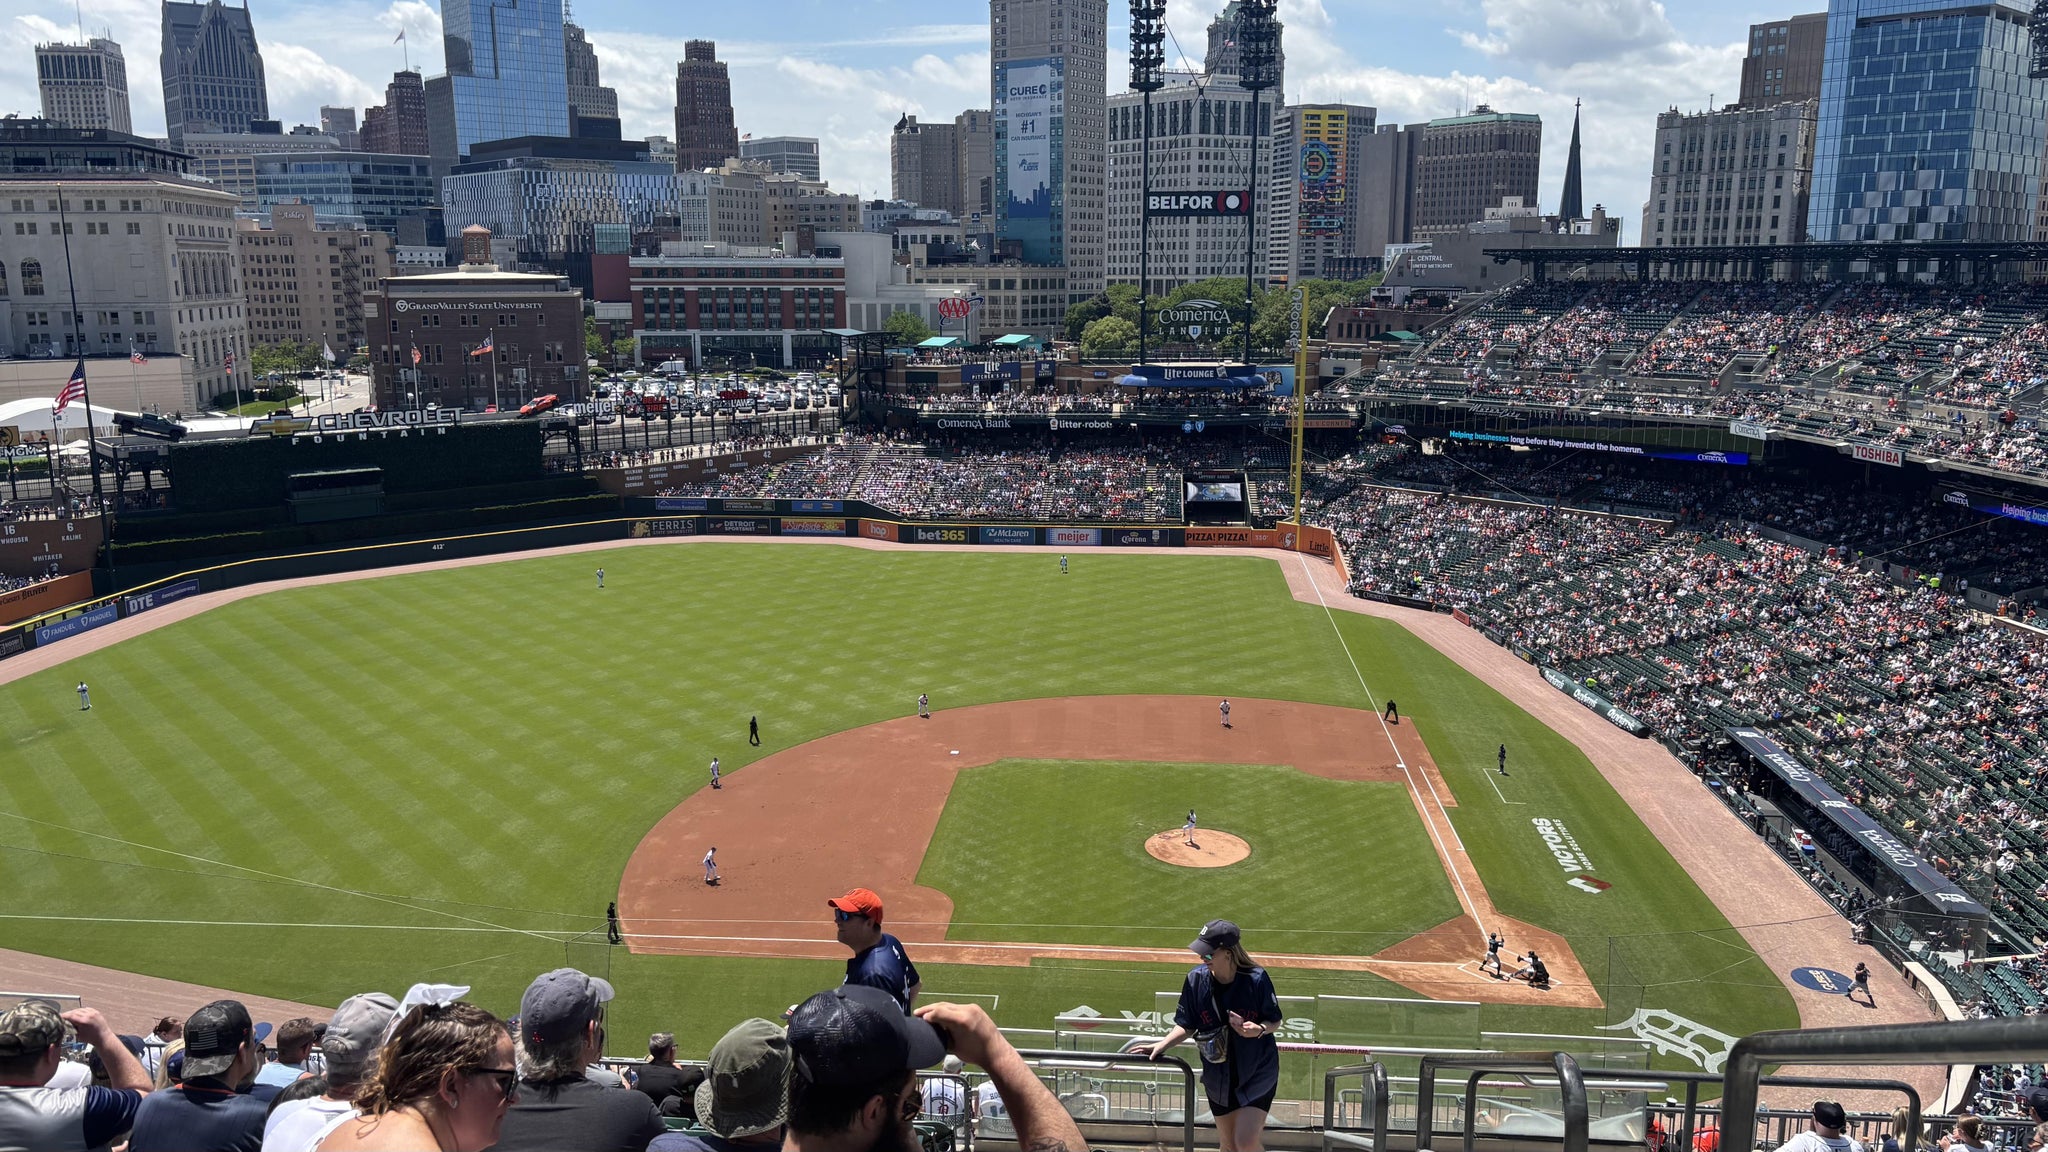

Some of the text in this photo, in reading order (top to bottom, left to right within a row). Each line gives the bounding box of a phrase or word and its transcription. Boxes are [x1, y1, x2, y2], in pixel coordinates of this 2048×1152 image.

[1010, 86, 1038, 96] CURE
[1020, 120, 1035, 134] #1
[1149, 196, 1213, 210] BELFOR
[408, 301, 543, 310] GRAND VALLEY STATE UNIVERSITY
[941, 298, 968, 317] AAA
[984, 362, 1000, 374] Lite
[1164, 368, 1214, 379] Lite LOUNGE
[574, 400, 616, 414] meijer
[320, 407, 464, 430] CHEVROLET
[985, 419, 1012, 428] Bank
[292, 428, 446, 446] FOUNTAIN
[1450, 430, 1644, 454] Helping businesses long before they invented the homerun.
[4, 446, 37, 458] MGM
[763, 450, 772, 458] 42
[1855, 446, 1900, 464] TOSHIBA
[2002, 502, 2032, 520] Helping
[4, 525, 16, 536] 16
[66, 522, 74, 532] 6
[652, 520, 694, 530] FERRIS
[786, 520, 820, 531] Surfside
[870, 522, 886, 536] hap
[918, 528, 966, 541] bet365
[998, 528, 1029, 538] McLaren
[1057, 531, 1090, 543] meijer
[1186, 532, 1248, 542] PIZZA! PIZZA!
[1121, 535, 1147, 544] Corona
[44, 542, 49, 552] 1
[1310, 540, 1329, 552] Little
[32, 554, 63, 562] WHITAKER
[129, 594, 154, 613] DTE
[51, 610, 112, 636] FANDUEL FANDUEL
[1531, 818, 1583, 873] VICTORS
[1552, 818, 1596, 871] HOME SOLUTIONS
